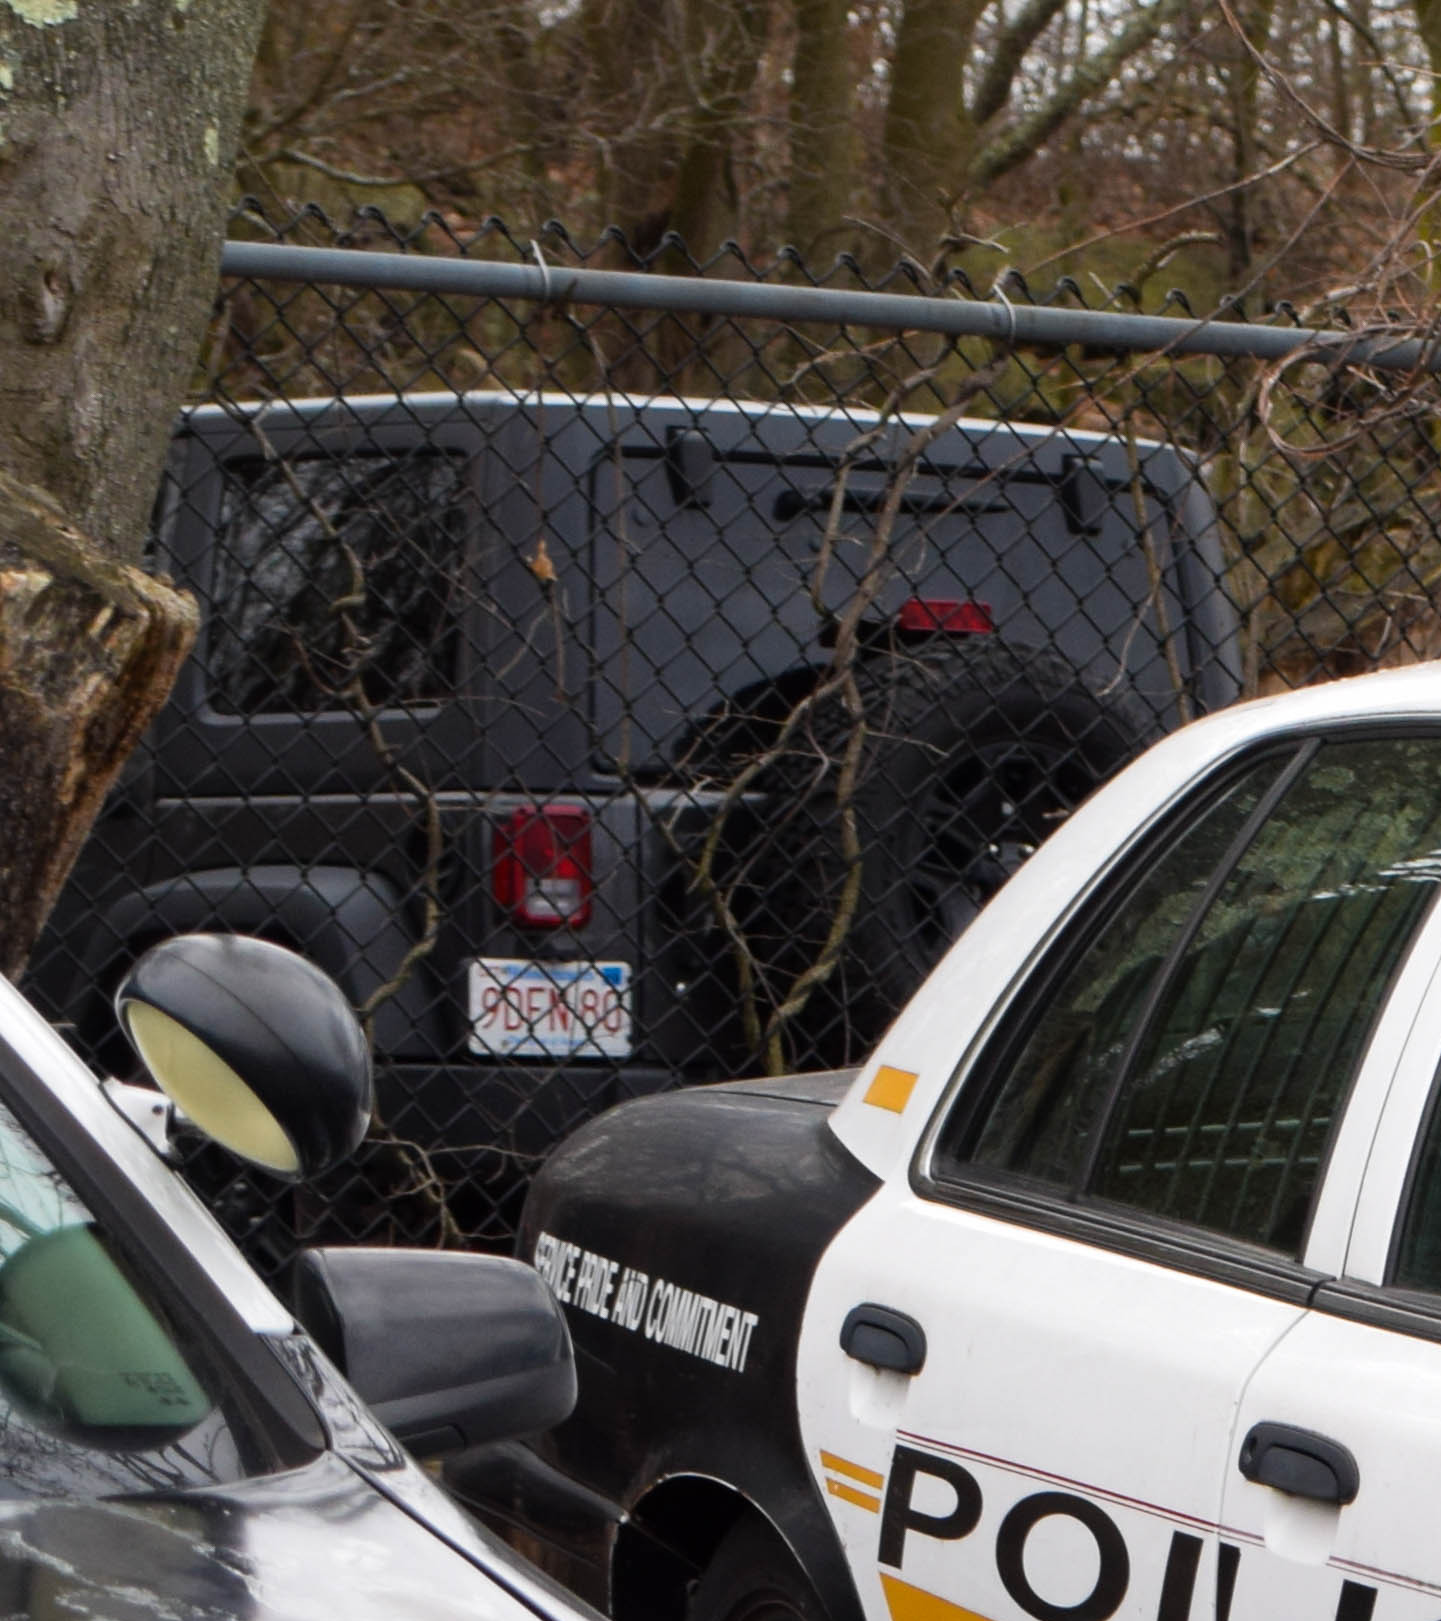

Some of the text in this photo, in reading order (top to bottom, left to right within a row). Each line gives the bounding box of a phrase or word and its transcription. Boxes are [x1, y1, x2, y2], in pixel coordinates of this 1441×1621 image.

[574, 1250, 620, 1319] PRIDE
[611, 1268, 649, 1331] AND
[644, 1278, 759, 1373] COMMITMENT
